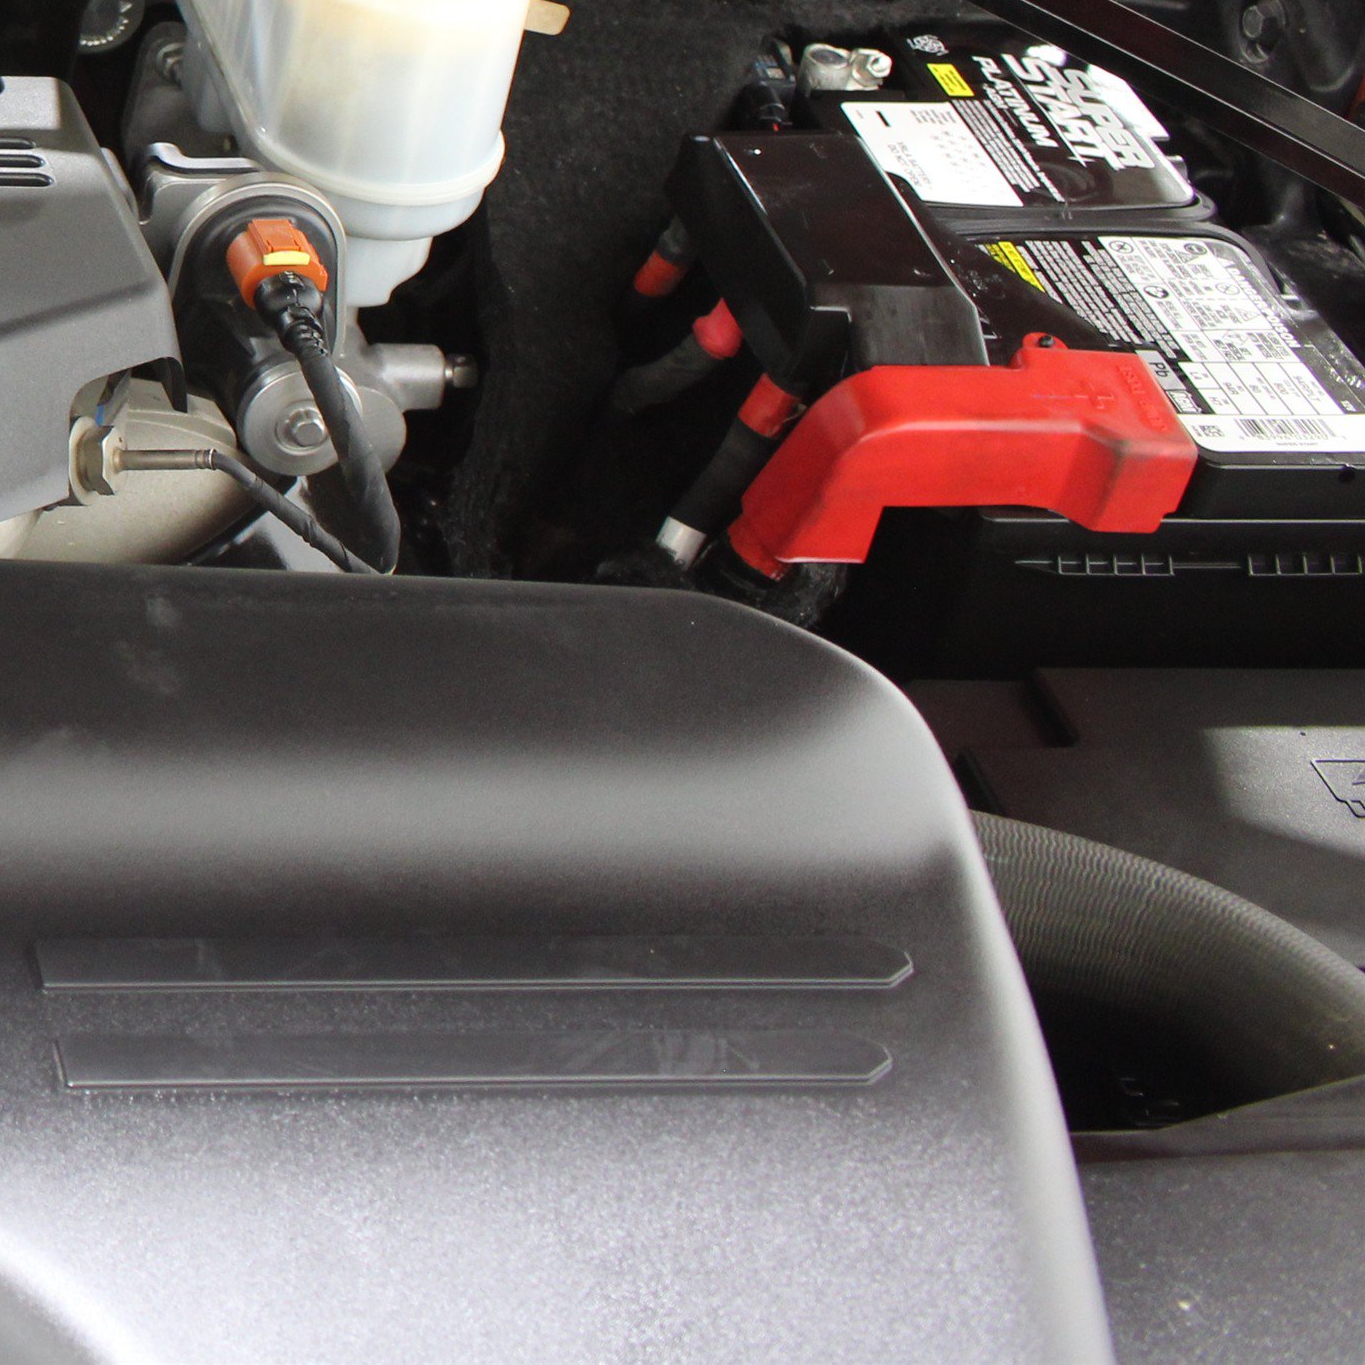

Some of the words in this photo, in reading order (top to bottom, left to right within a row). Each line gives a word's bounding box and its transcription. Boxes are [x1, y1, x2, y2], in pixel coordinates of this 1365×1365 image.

[971, 55, 1060, 148] PLATINUM
[1001, 53, 1126, 171] START
[1062, 67, 1155, 169] SUPER
[1148, 362, 1172, 378] Pb
